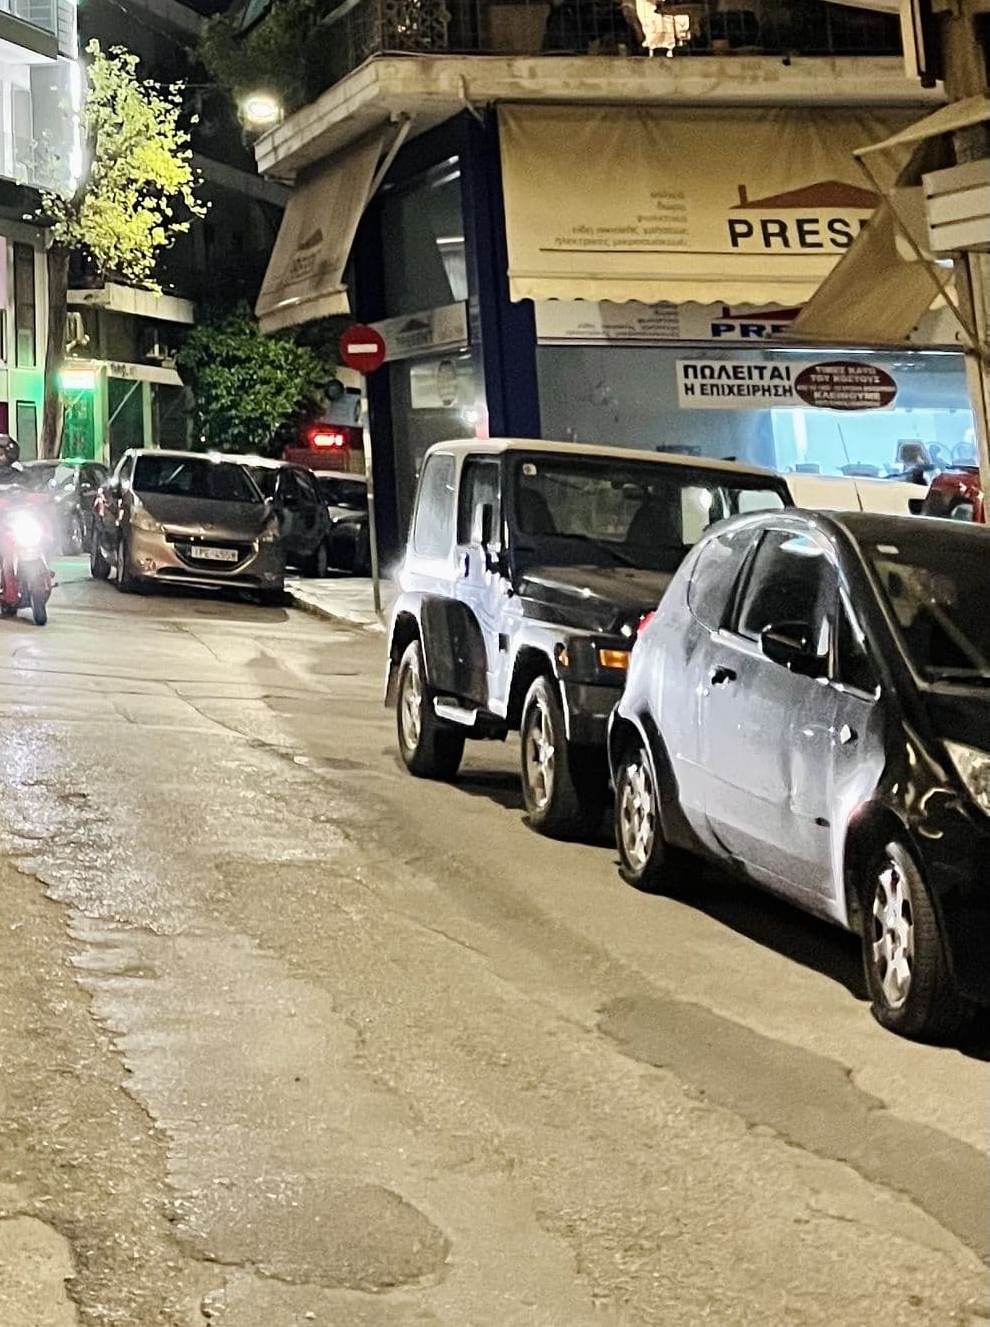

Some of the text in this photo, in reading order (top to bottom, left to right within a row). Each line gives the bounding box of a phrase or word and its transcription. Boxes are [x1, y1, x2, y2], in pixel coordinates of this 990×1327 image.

[683, 364, 791, 381] ΠΩΛΕΙΤΑΙ
[684, 383, 695, 396] Η
[700, 383, 793, 397] ΕΠΙΧΕΙΡΗΣΗ
